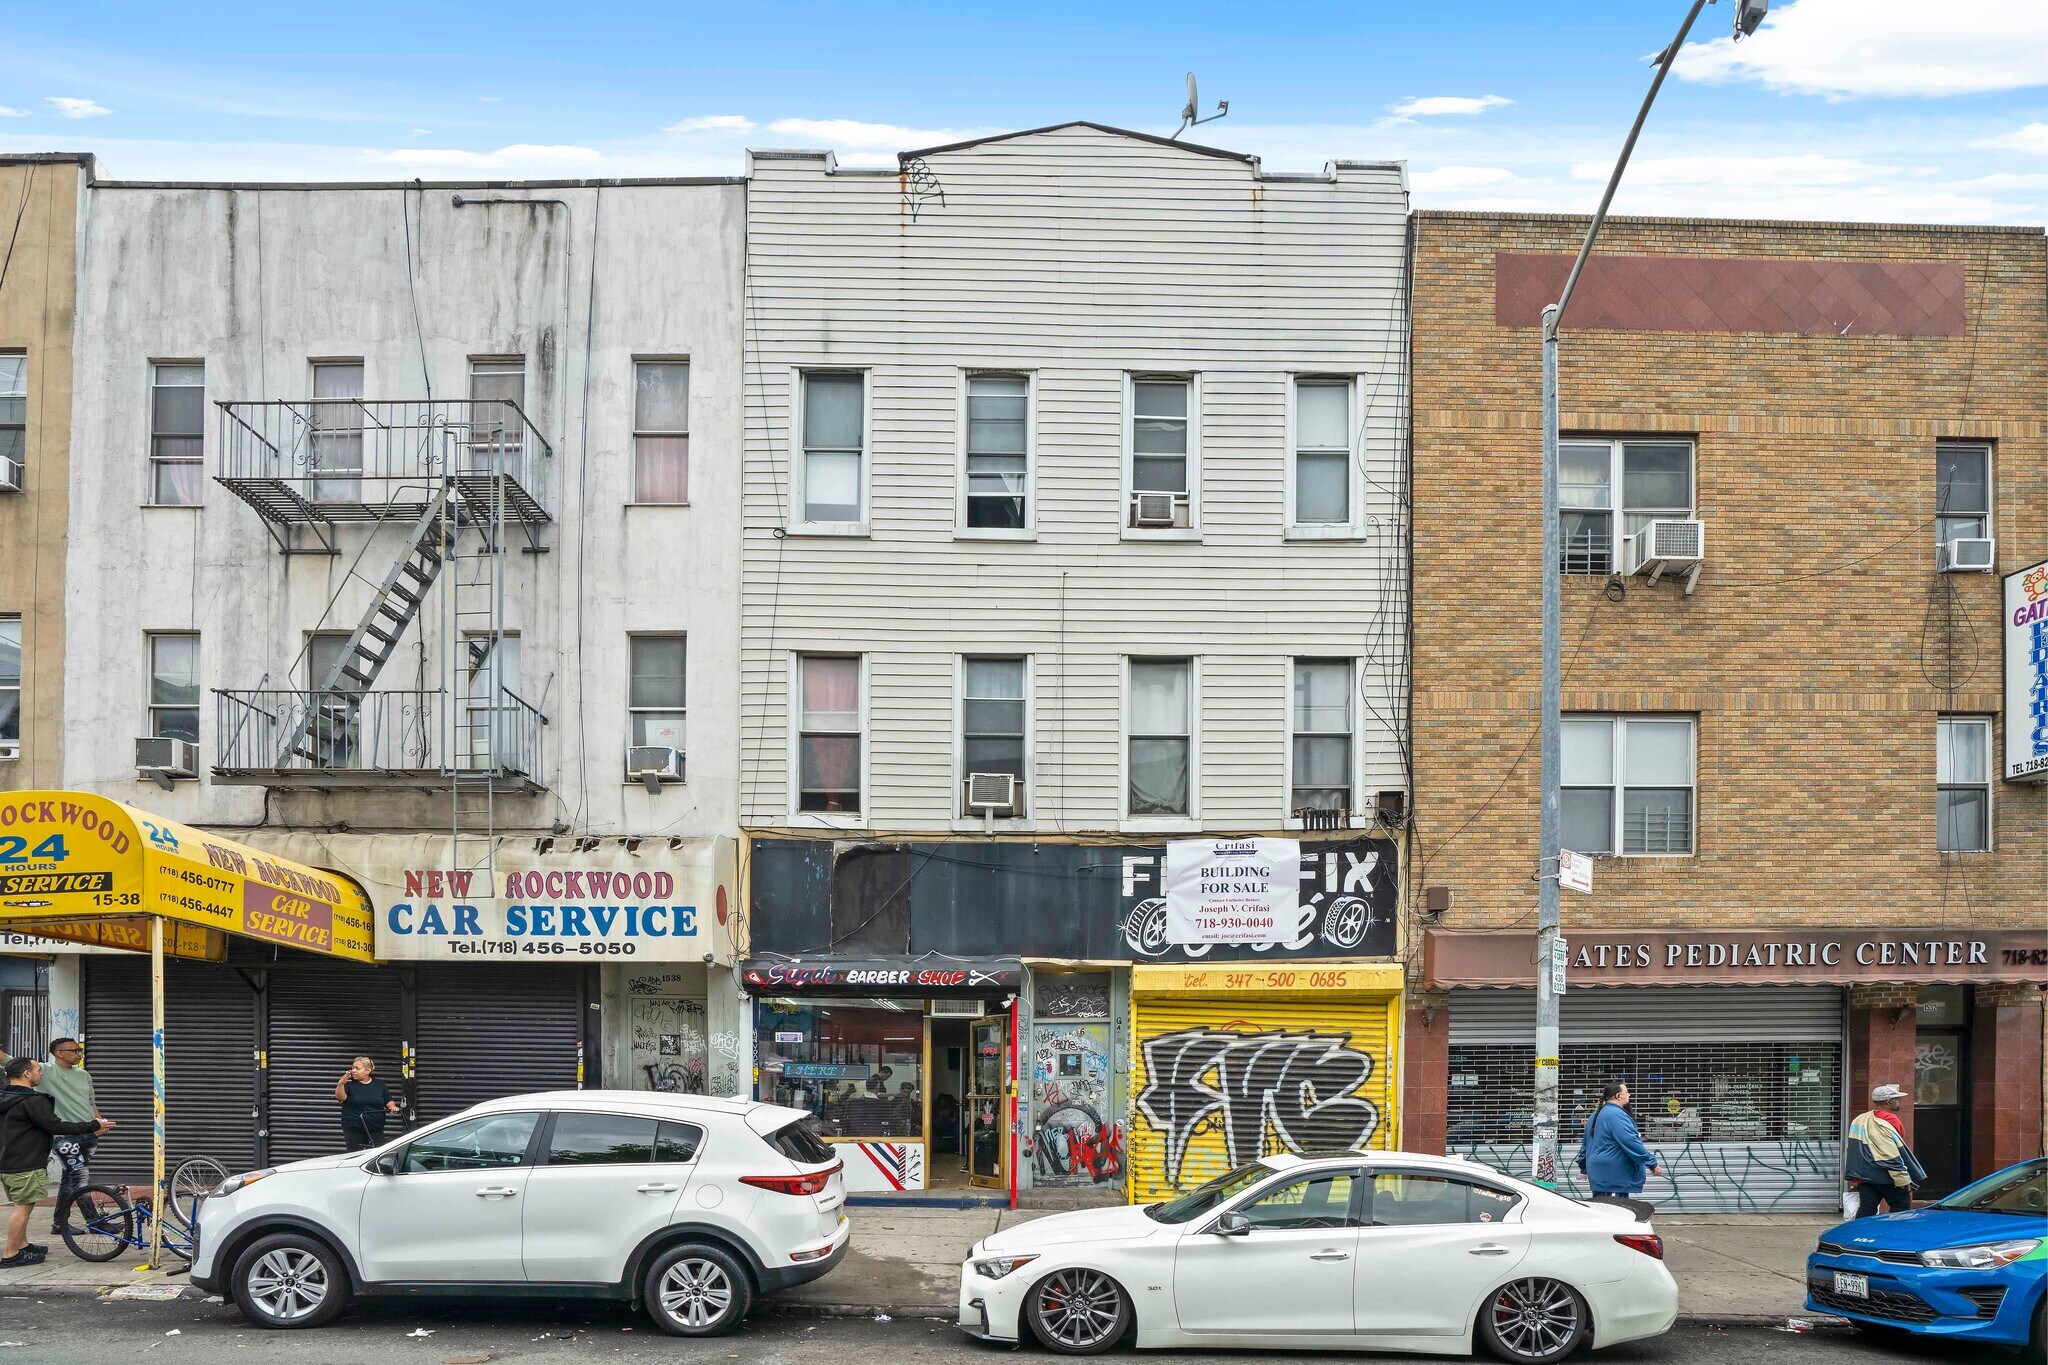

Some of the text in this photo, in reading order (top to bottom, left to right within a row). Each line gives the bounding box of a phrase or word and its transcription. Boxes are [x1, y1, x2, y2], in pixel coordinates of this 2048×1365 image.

[2013, 598, 2048, 627] GAT
[2012, 763, 2024, 775] TEL
[142, 821, 178, 848] 24
[0, 834, 69, 863] 24
[1215, 841, 1255, 850] Crifasi
[5, 863, 57, 871] HOURS
[203, 842, 247, 876] NEW
[251, 857, 341, 904] ROCKWOOD
[1200, 867, 1270, 878] BUILDING
[4, 874, 105, 893] SERVICE
[160, 866, 234, 893] (718) 456-0777
[405, 871, 674, 899] NEW ROCKWOOD
[1201, 883, 1269, 893] FOR SALE
[93, 893, 140, 906] 15-38
[160, 893, 233, 918] (718) 456-4447
[271, 894, 310, 919] CAR
[1199, 905, 1228, 914] Joseph
[1241, 904, 1270, 912] Crifasi
[247, 911, 330, 946] SERVICE
[388, 904, 698, 936] CAR SERVICE
[1195, 918, 1274, 928] 718-930-0040
[522, 942, 636, 955] 456-5050
[1666, 942, 1841, 967] PEDIATRIC
[1855, 941, 1989, 965] CENTER
[847, 970, 910, 984] BARBER
[917, 970, 966, 985] SHOP
[1184, 973, 1208, 987] tel.
[60, 1142, 80, 1154] 88
